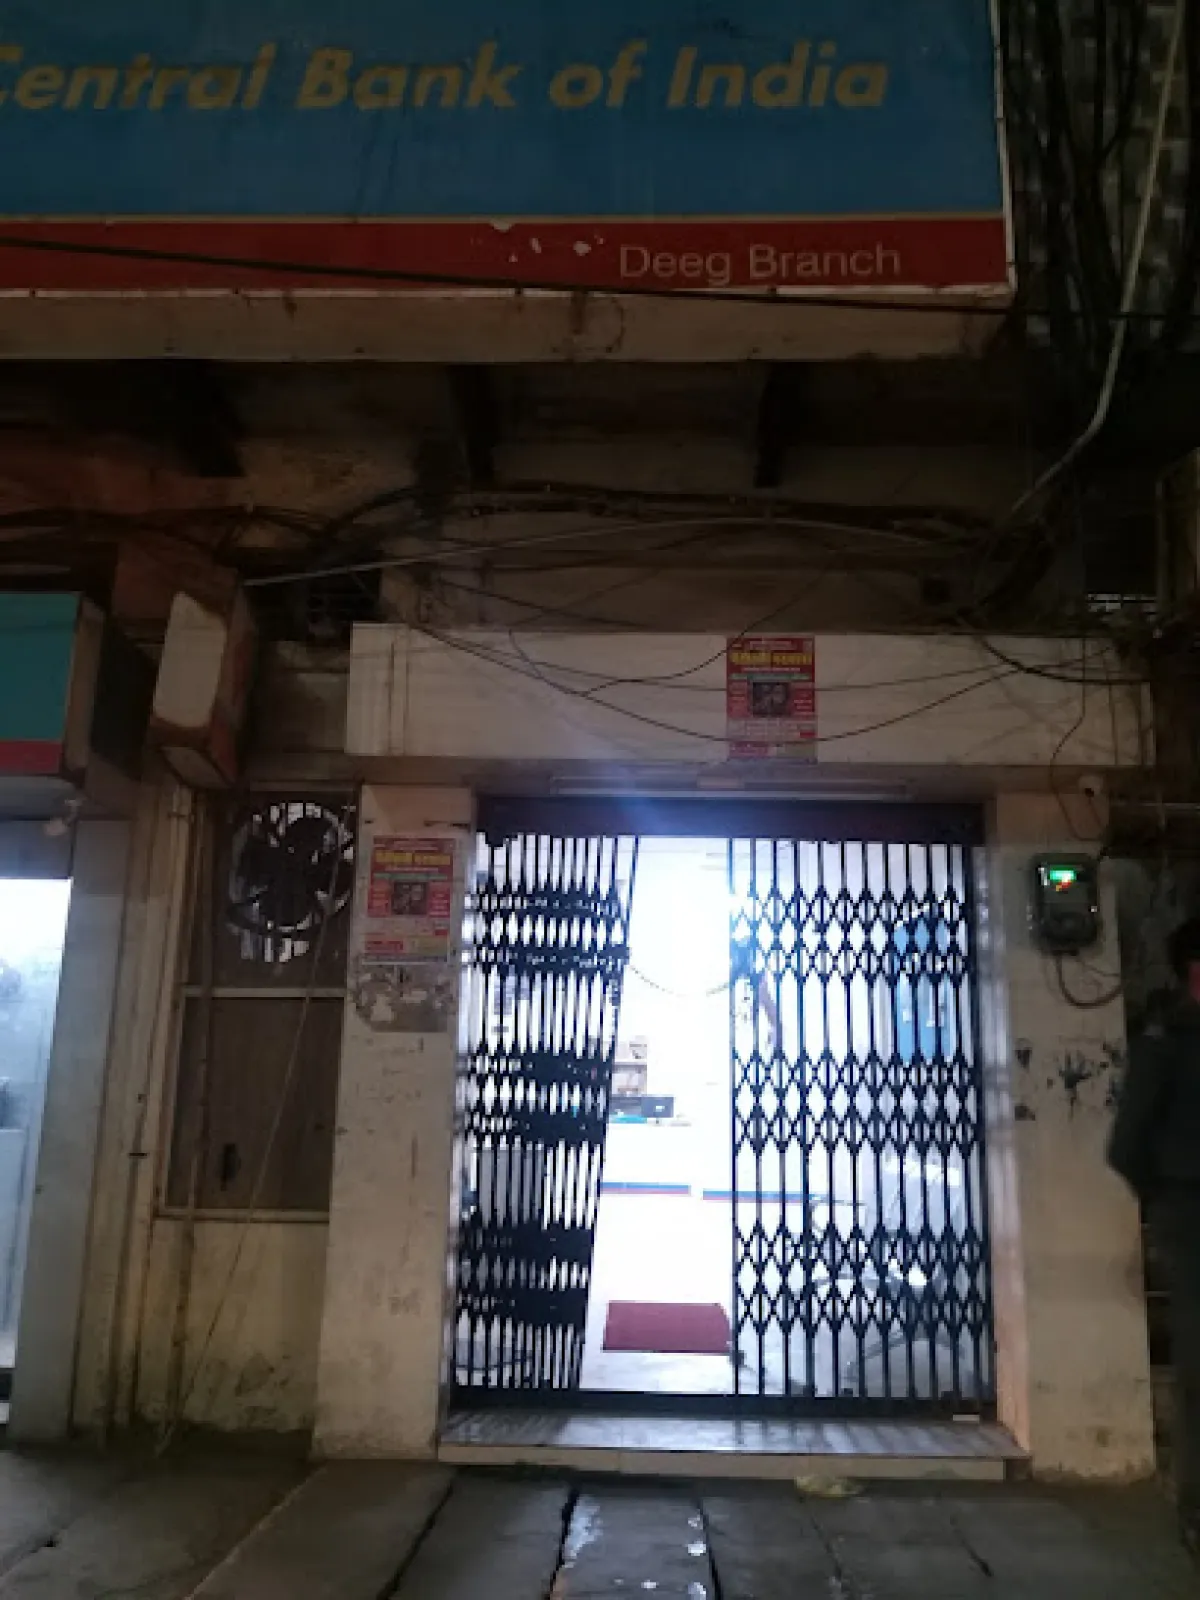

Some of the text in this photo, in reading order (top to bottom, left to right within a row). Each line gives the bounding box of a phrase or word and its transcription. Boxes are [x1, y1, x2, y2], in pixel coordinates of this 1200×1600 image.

[298, 41, 521, 109] Bank
[549, 39, 649, 108] of
[668, 41, 890, 108] India
[619, 242, 901, 285] Deeg Branch
